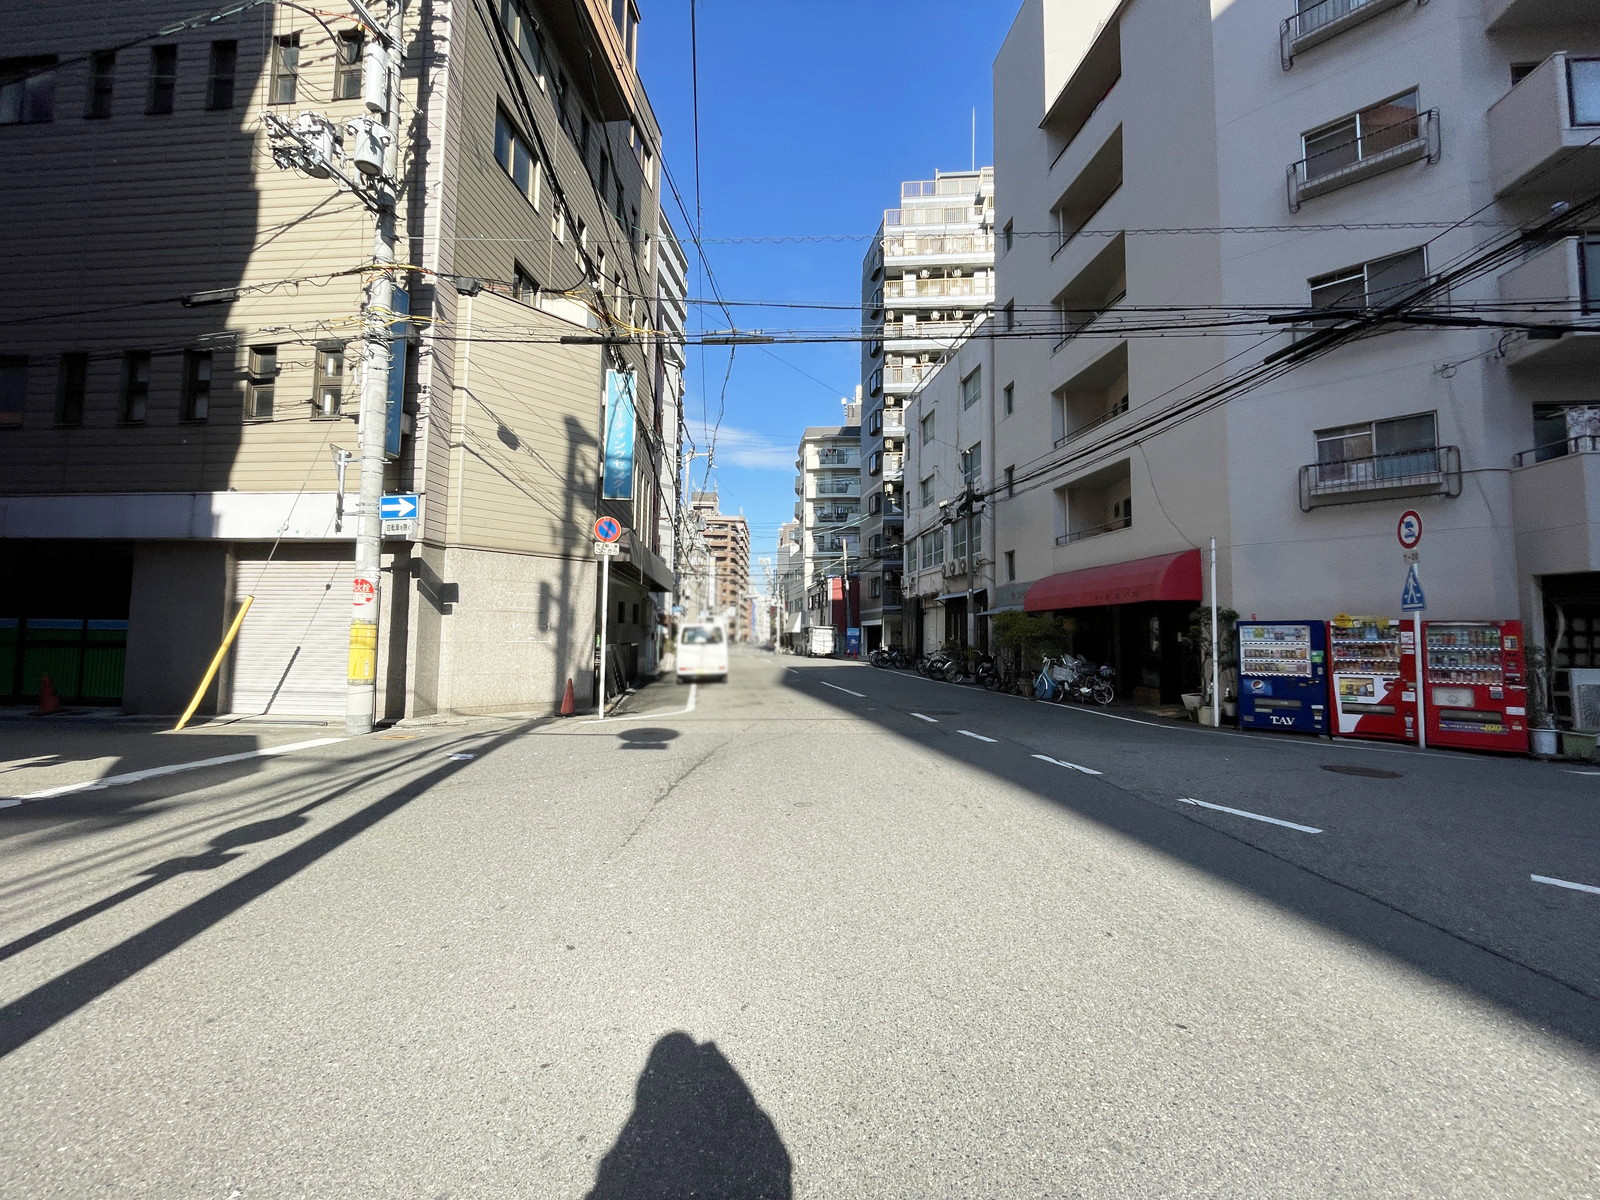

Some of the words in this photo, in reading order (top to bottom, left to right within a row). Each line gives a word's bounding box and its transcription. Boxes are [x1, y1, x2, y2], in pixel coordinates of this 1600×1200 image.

[595, 547, 618, 555] ここから
[1403, 552, 1419, 562] T-20
